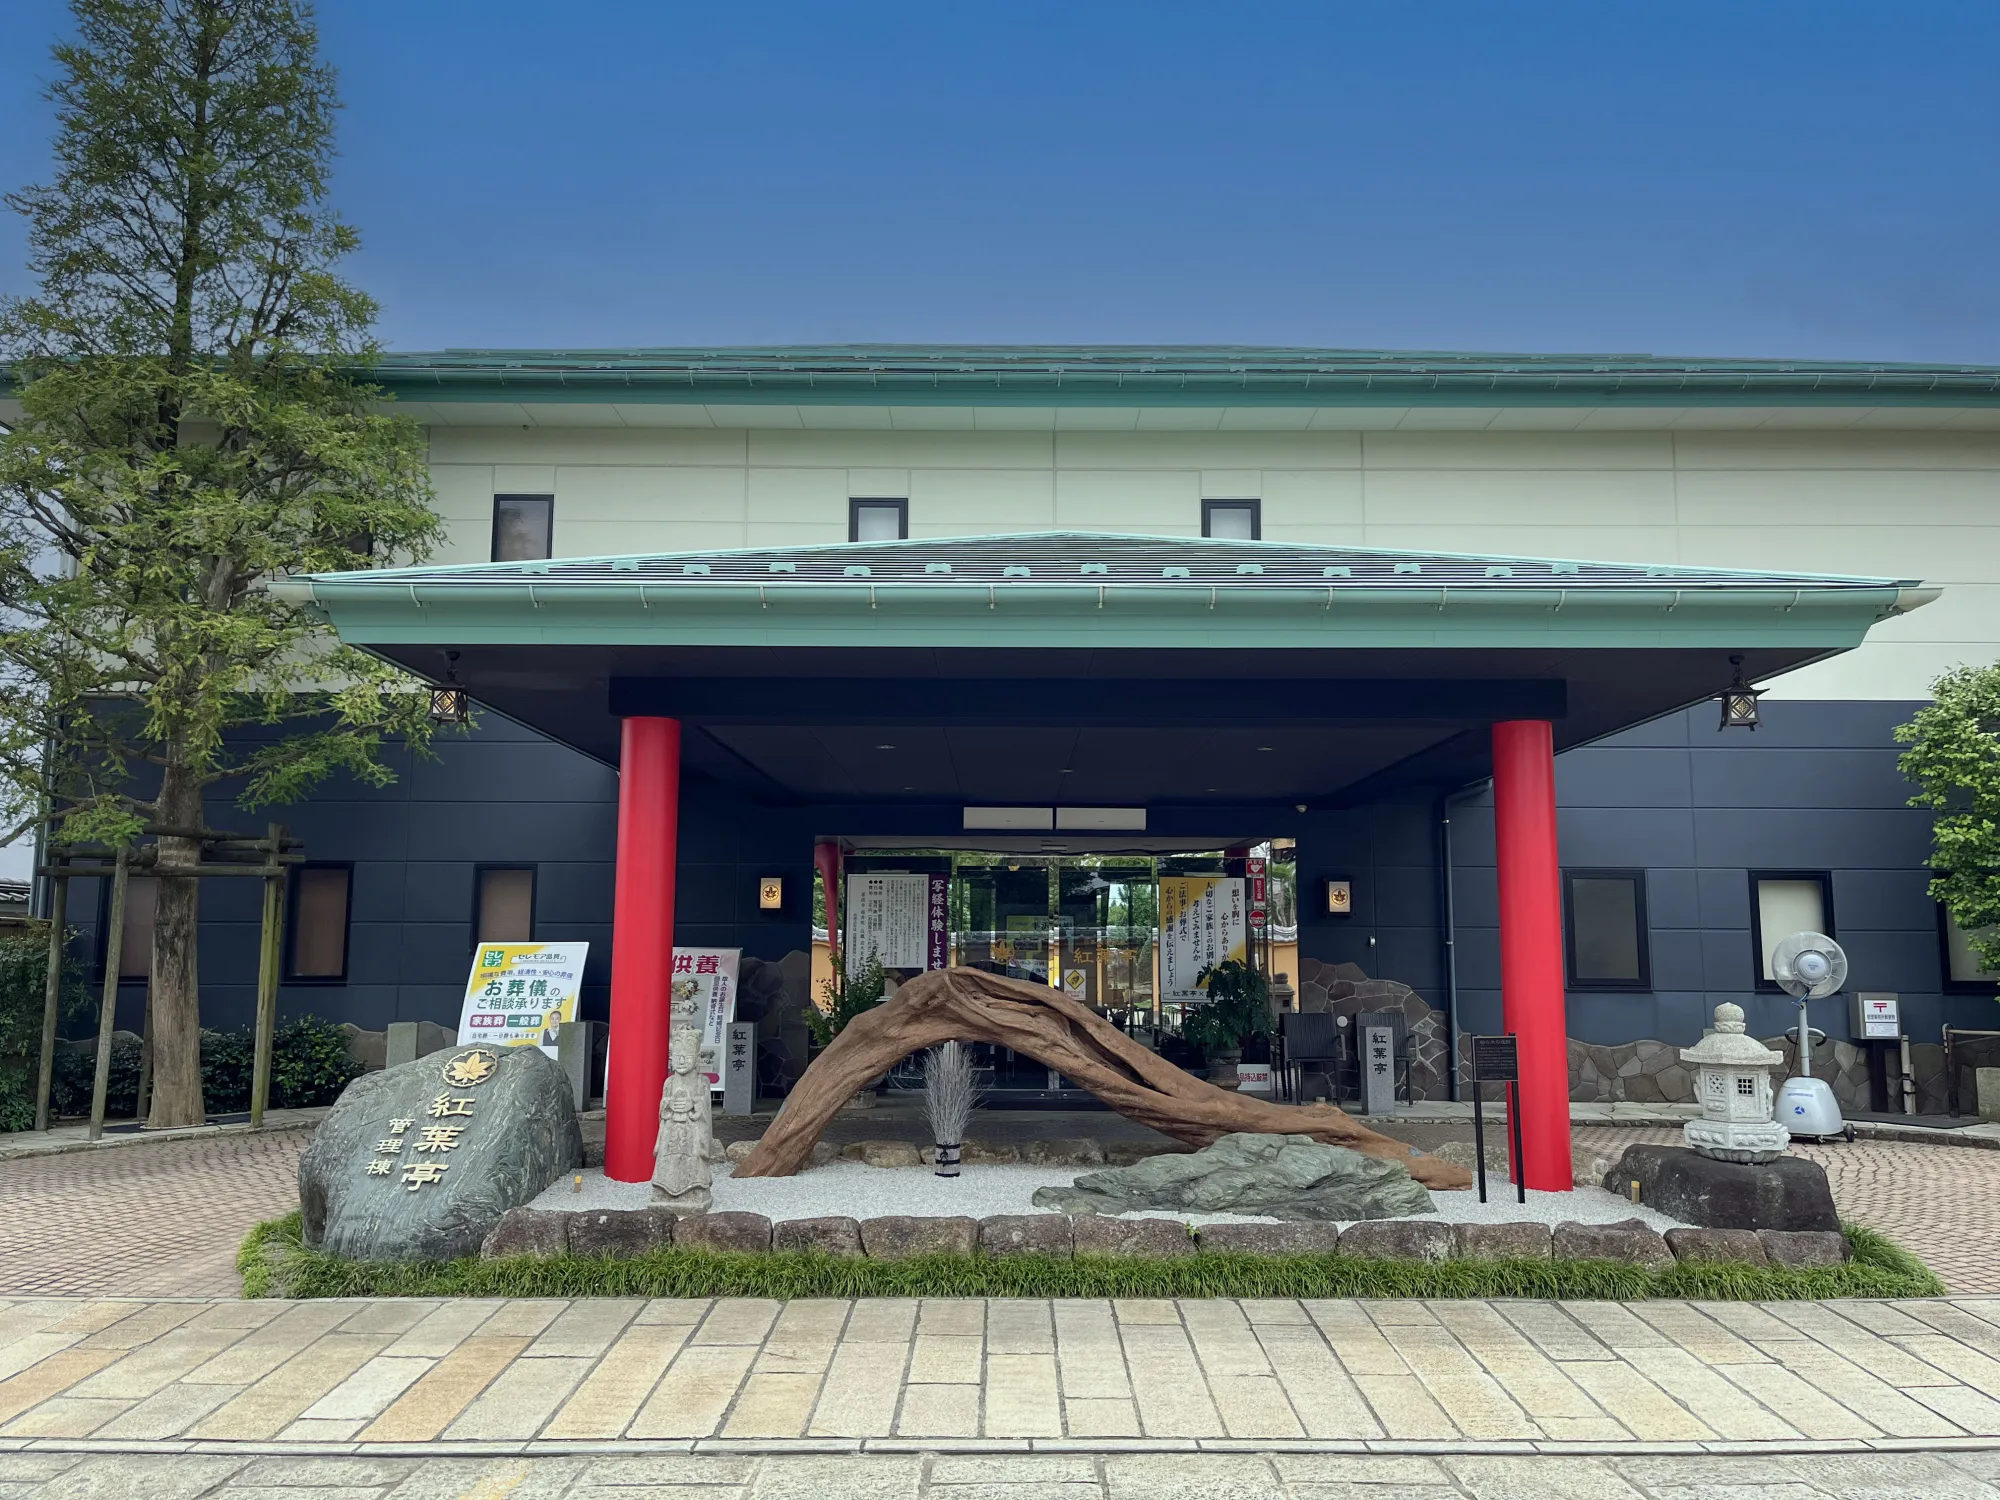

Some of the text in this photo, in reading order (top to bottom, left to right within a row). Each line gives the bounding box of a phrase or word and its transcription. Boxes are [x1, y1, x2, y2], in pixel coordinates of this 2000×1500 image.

[931, 880, 945, 970] 写経体験しませ
[1165, 886, 1174, 987] 心からの感謝を伝えましょう
[1192, 900, 1201, 961] 考えてみませんか
[672, 954, 720, 974] 供養
[477, 997, 566, 1010] ご相談承ります
[485, 979, 560, 996] お葬儀の
[471, 1016, 541, 1026] 家族葬 一般葬
[732, 1029, 747, 1072] 紅葉亭
[1372, 1032, 1388, 1075] 紅葉亭
[364, 1117, 416, 1176] 管理棟
[400, 1091, 476, 1192] 紅葉亭
